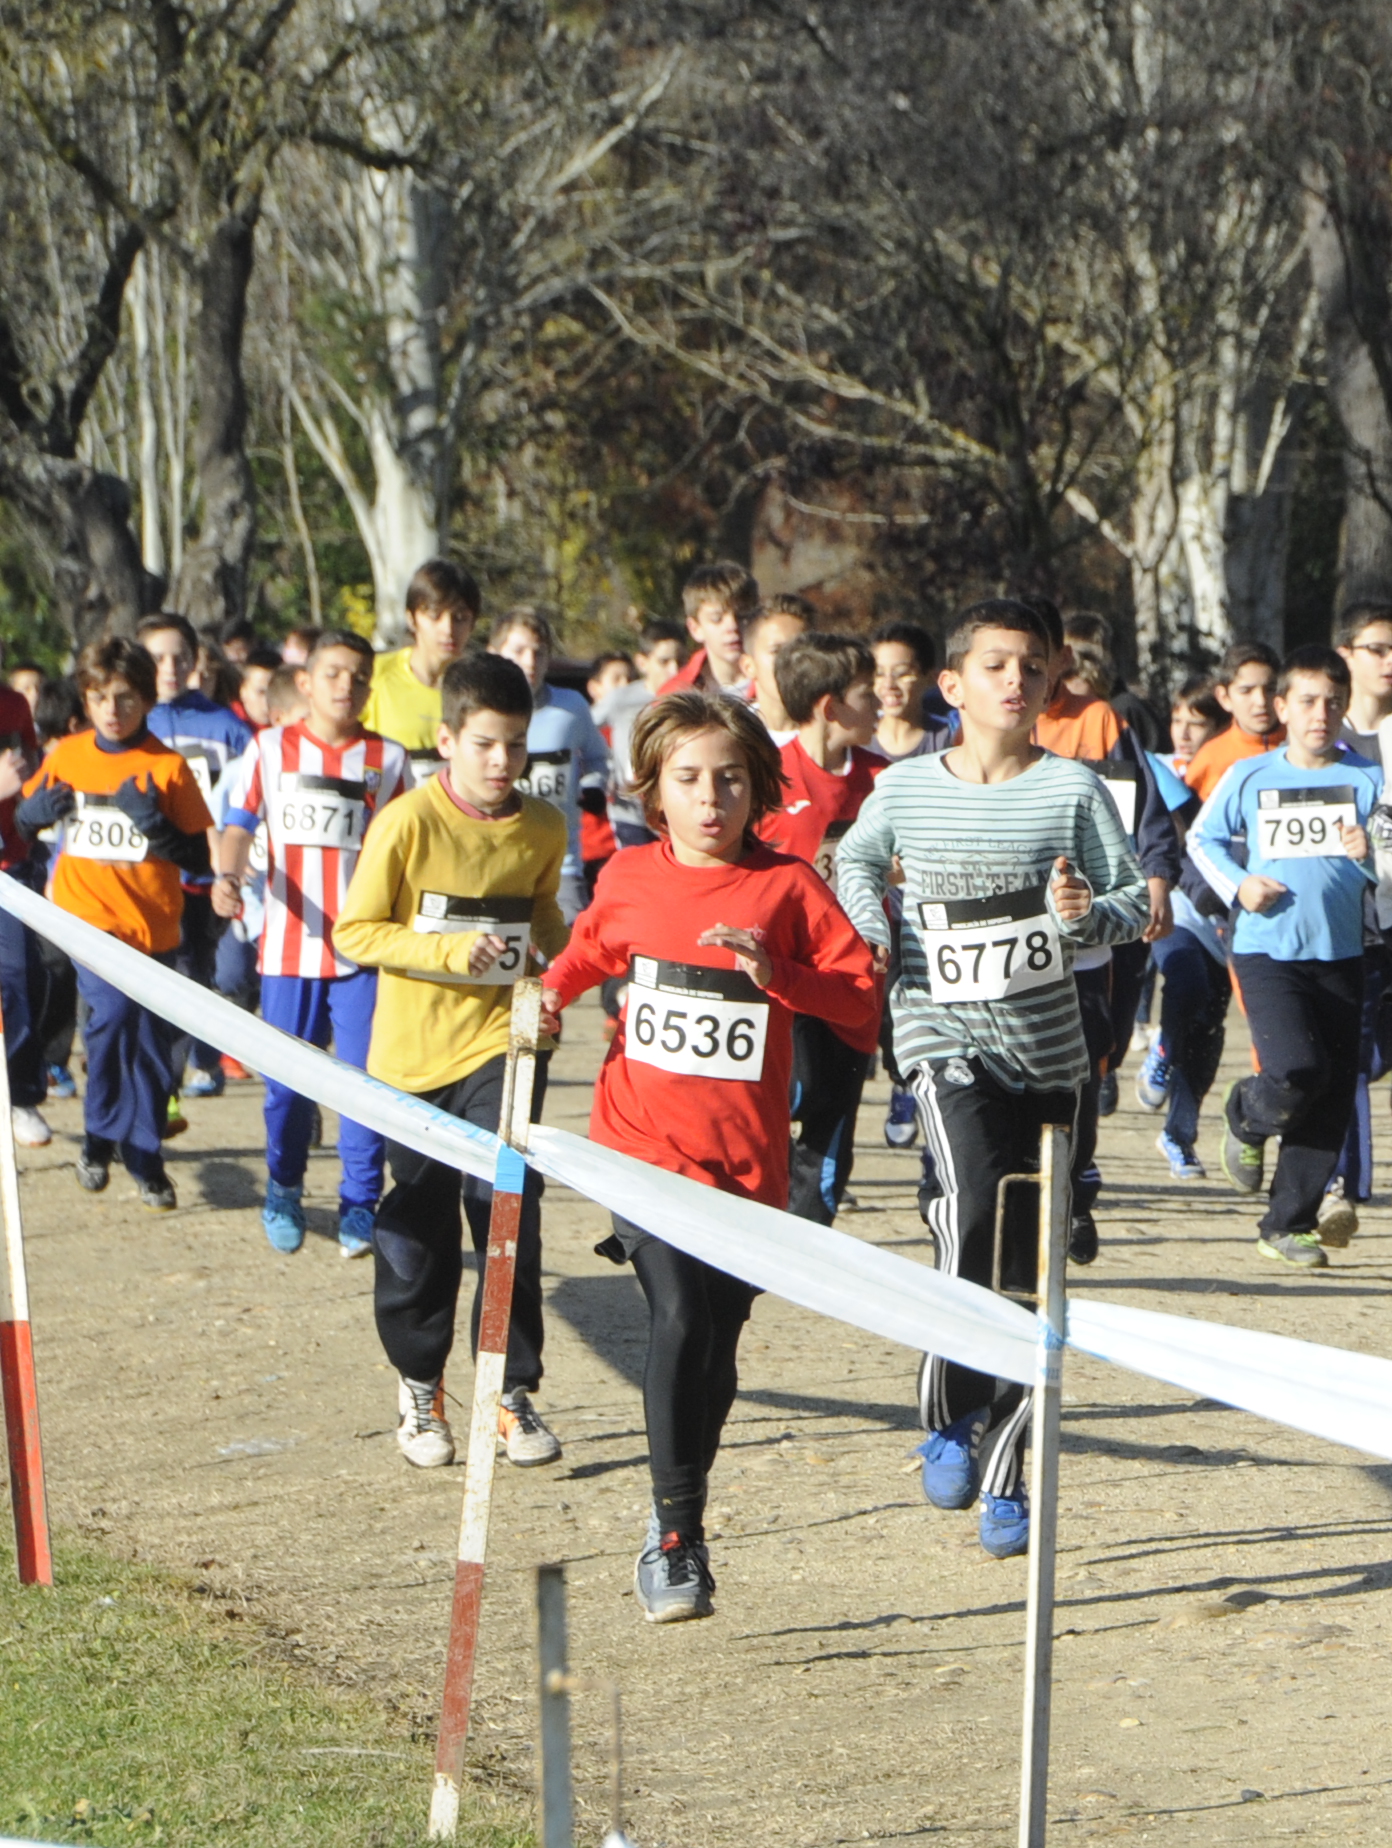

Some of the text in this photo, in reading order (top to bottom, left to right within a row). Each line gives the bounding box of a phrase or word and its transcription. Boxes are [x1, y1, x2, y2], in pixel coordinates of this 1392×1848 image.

[70, 817, 144, 849] 7808
[282, 803, 354, 837] 6871
[921, 869, 974, 897] FIRST
[936, 930, 1053, 985] 6778
[634, 1002, 757, 1062] 6536
